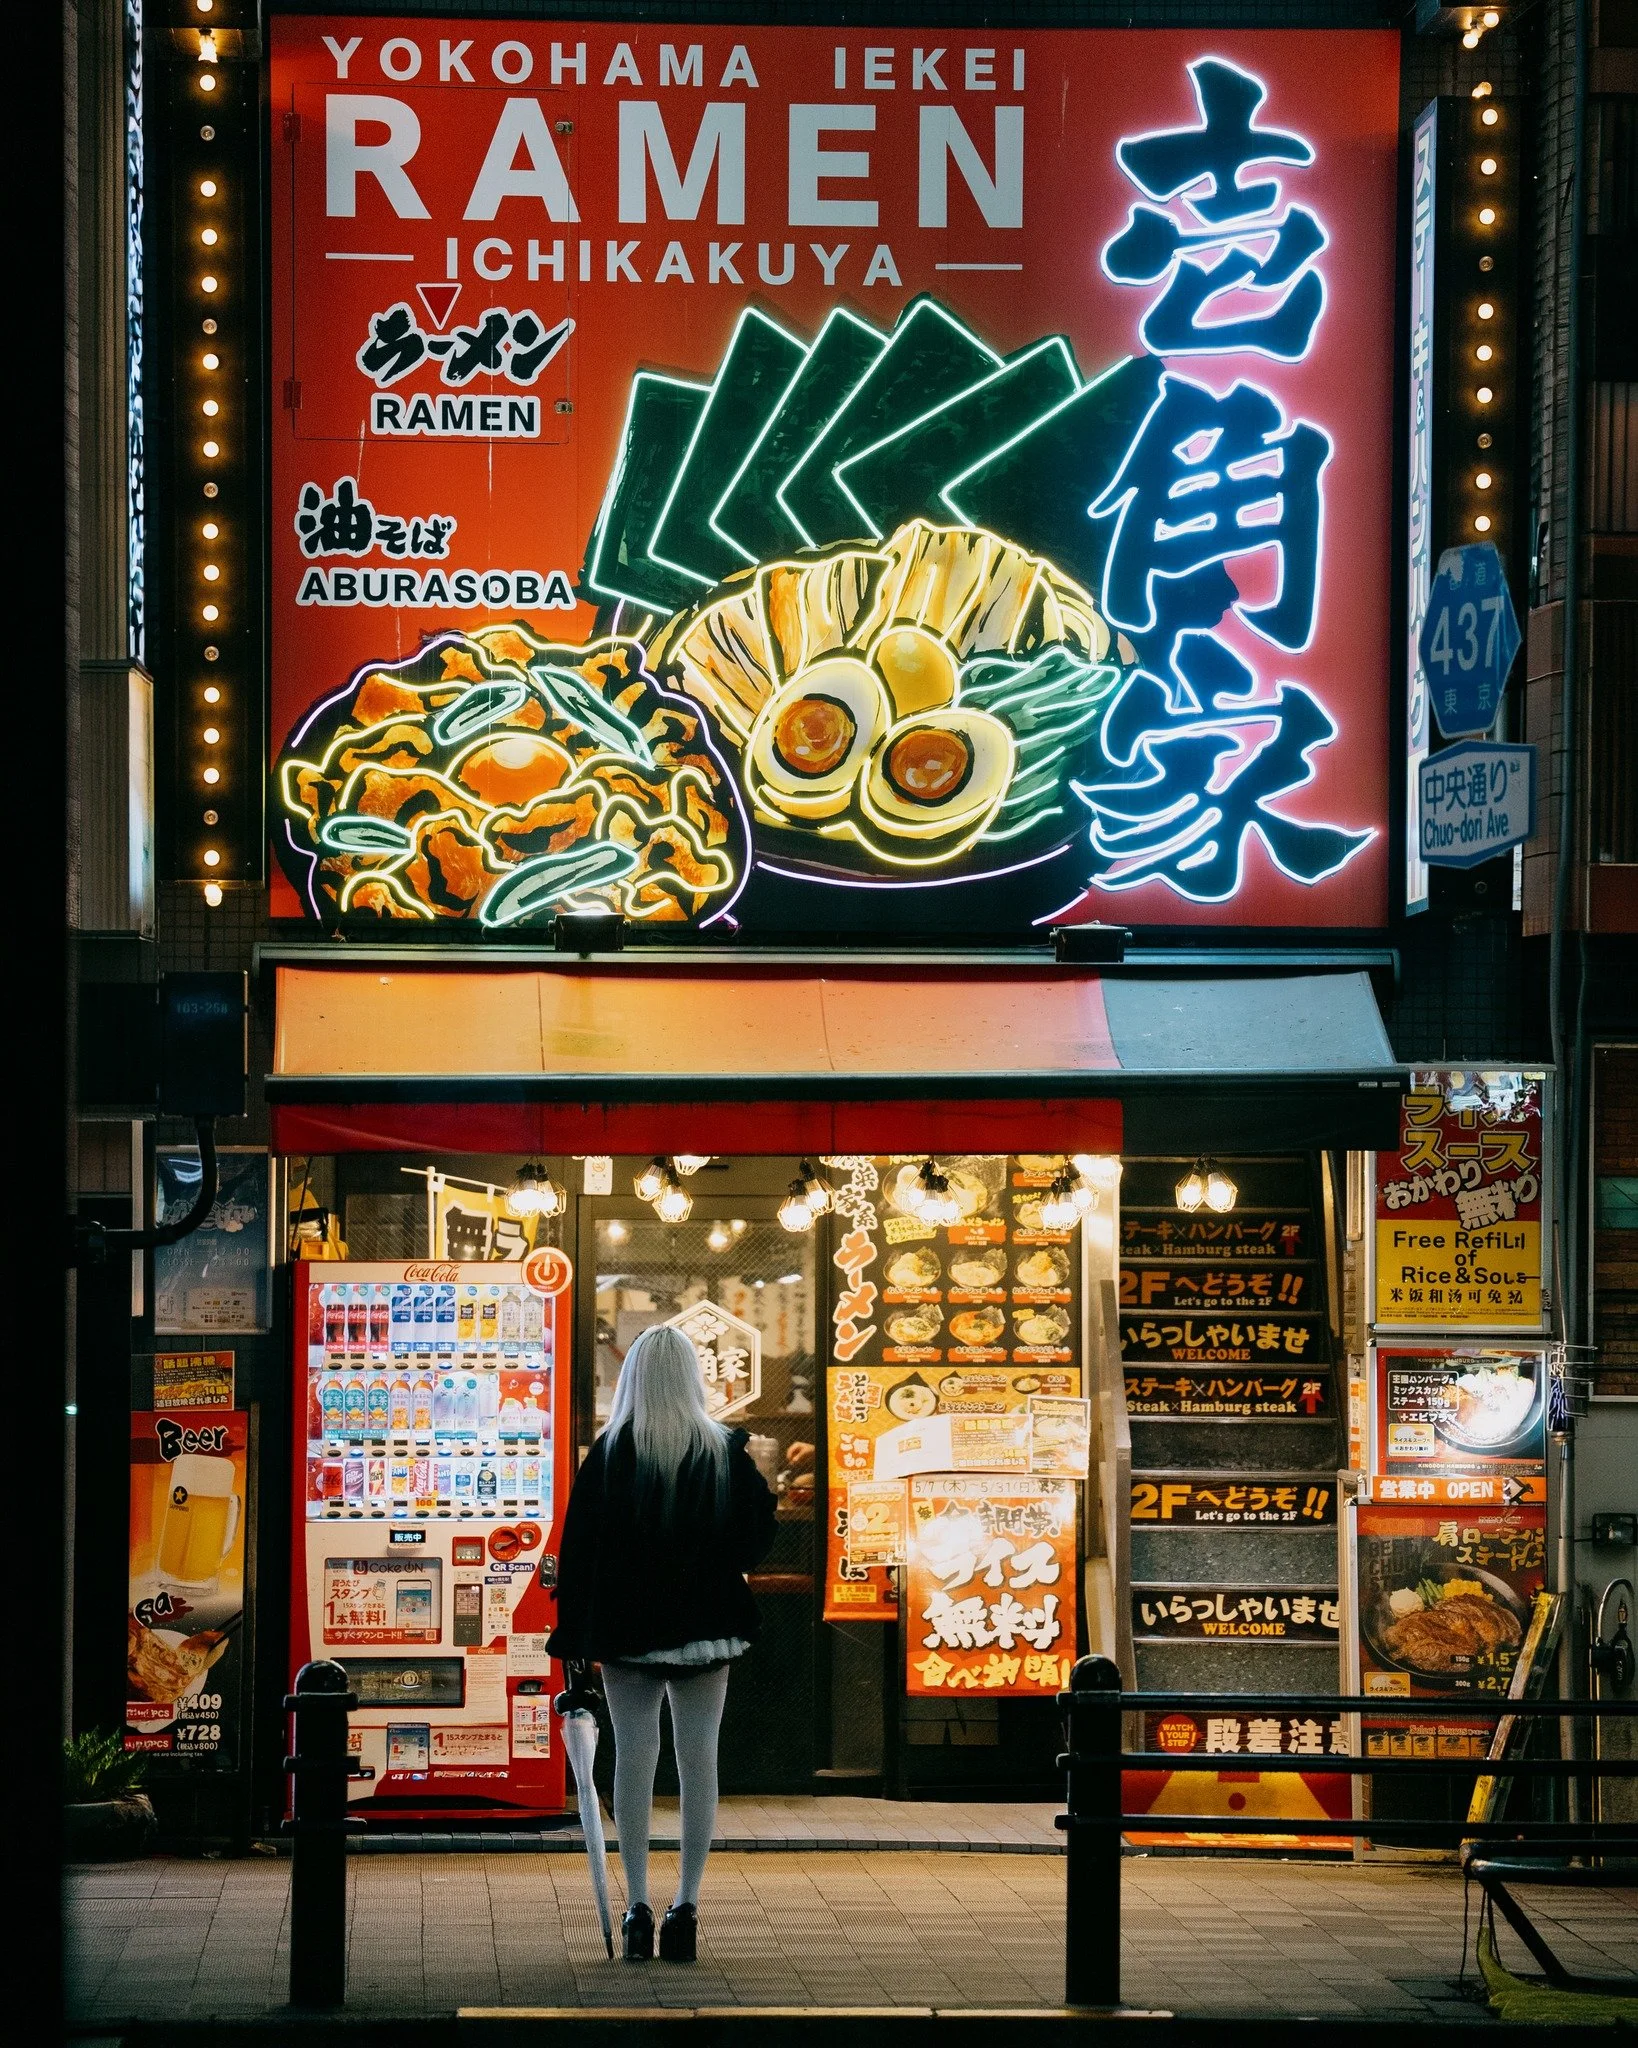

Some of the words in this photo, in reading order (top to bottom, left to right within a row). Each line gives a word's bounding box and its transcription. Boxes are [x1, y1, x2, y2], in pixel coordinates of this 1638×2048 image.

[322, 36, 759, 88] YOKOHAMA
[834, 47, 1026, 92] IEKEI
[326, 93, 1024, 230] RAMEN
[446, 236, 902, 288] ICHIKAKUYA
[359, 303, 573, 387] ラーメン
[374, 397, 537, 435] RAMEN
[297, 478, 456, 558] 油そば
[299, 569, 574, 607] ABURASOBA
[1430, 595, 1505, 675] 437
[1443, 684, 1492, 714] 東京
[1424, 759, 1508, 814] 中央通り
[1424, 810, 1483, 849] Chuo-dori
[1487, 812, 1510, 840] Ave
[1384, 1160, 1482, 1209] おかわり
[1120, 1219, 1278, 1241] テーキ×ハンバーグ
[1281, 1225, 1300, 1237] 2F
[1393, 1230, 1446, 1249] Free
[1235, 1244, 1277, 1256] steak
[1454, 1249, 1478, 1267] of
[403, 1264, 461, 1283] Coca-Cola
[834, 1230, 877, 1361] ラーメン
[1174, 1297, 1201, 1306] Let's
[1203, 1298, 1217, 1308] go
[1220, 1297, 1233, 1306] to
[1236, 1297, 1255, 1306] the
[1258, 1297, 1273, 1306] 2F
[1120, 1321, 1310, 1354] いらっしゃいませ
[1172, 1349, 1251, 1361] WELCOME
[1303, 1382, 1322, 1394] 2F
[1393, 1386, 1446, 1395] ミックスカット
[1255, 1401, 1297, 1413] steak
[156, 1418, 228, 1462] Beer
[1379, 1480, 1435, 1499] 営業中
[1447, 1480, 1494, 1499] OPEN
[1196, 1511, 1224, 1521] Let's
[1226, 1512, 1241, 1523] go
[1243, 1511, 1257, 1520] to
[1260, 1511, 1279, 1520] the
[1282, 1511, 1298, 1521] 2F
[394, 1533, 422, 1542] 販売中
[369, 1562, 402, 1573] Coke
[492, 1563, 507, 1571] QR
[508, 1563, 533, 1571] Scan!
[330, 1588, 372, 1599] スタンプ
[1141, 1594, 1340, 1629] いらっしゃいませ
[922, 1593, 1061, 1650] 無料
[1202, 1622, 1286, 1636] WELCOME
[178, 1694, 222, 1711] ¥409
[177, 1725, 221, 1741] ¥728
[1166, 1731, 1190, 1739] YOUR
[1167, 1739, 1189, 1747] STEP
